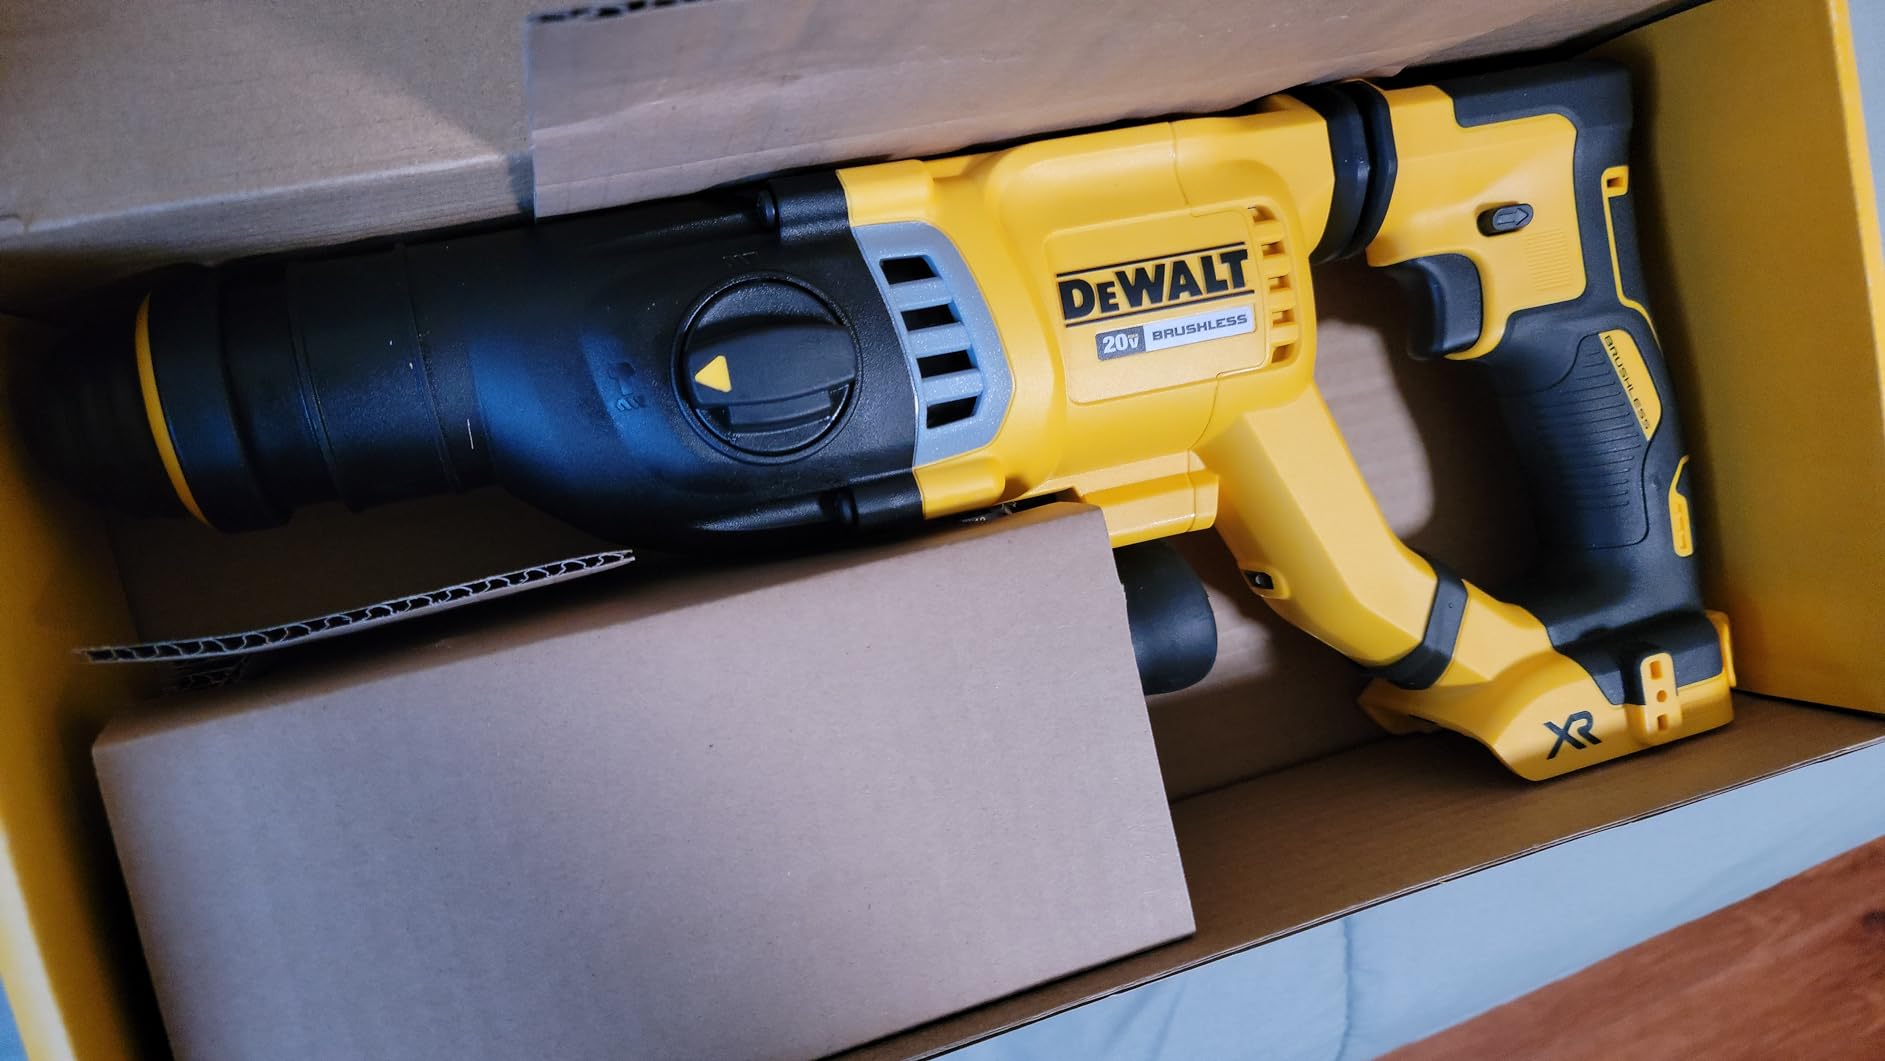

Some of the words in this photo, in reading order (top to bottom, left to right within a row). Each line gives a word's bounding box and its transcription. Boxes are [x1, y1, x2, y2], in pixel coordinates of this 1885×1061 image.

[1152, 314, 1248, 341] BRUSHLESS
[1605, 336, 1649, 429] BRUSHLESS
[1543, 710, 1602, 760] XR
